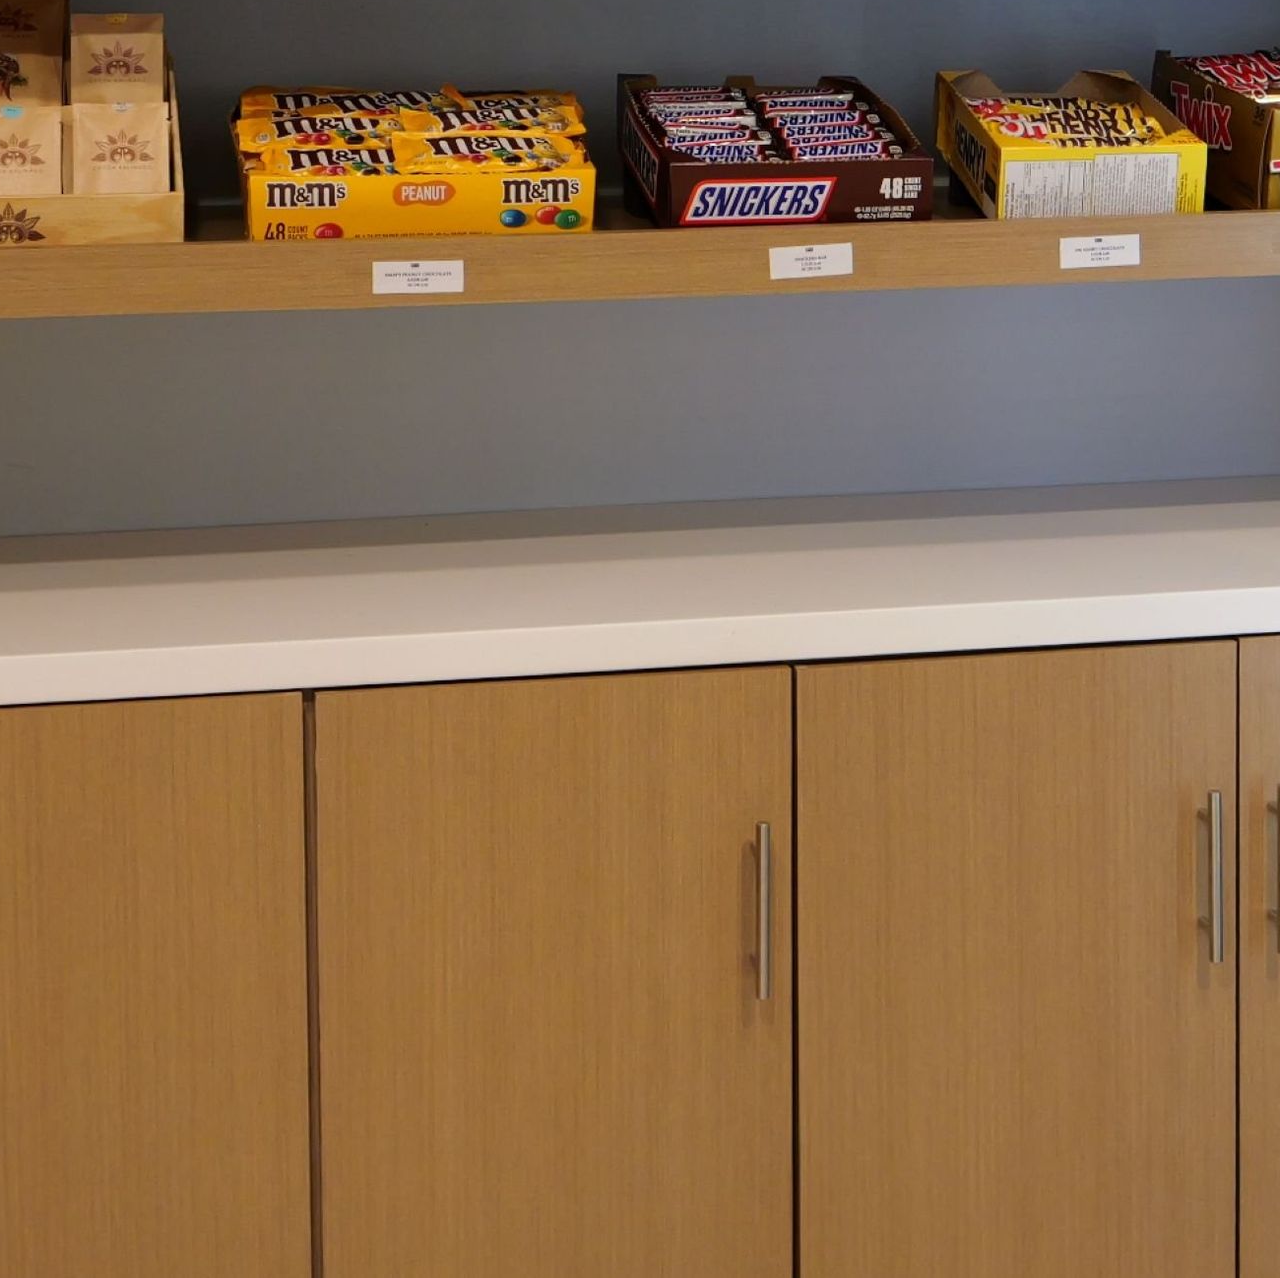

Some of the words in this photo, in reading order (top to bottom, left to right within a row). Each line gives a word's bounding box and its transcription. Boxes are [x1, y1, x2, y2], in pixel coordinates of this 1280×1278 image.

[1171, 81, 1233, 151] Twix
[401, 185, 448, 201] PEANUT
[879, 177, 903, 199] 48
[692, 184, 827, 218] SNICKERS
[264, 222, 285, 240] 48
[287, 225, 308, 233] COUNT
